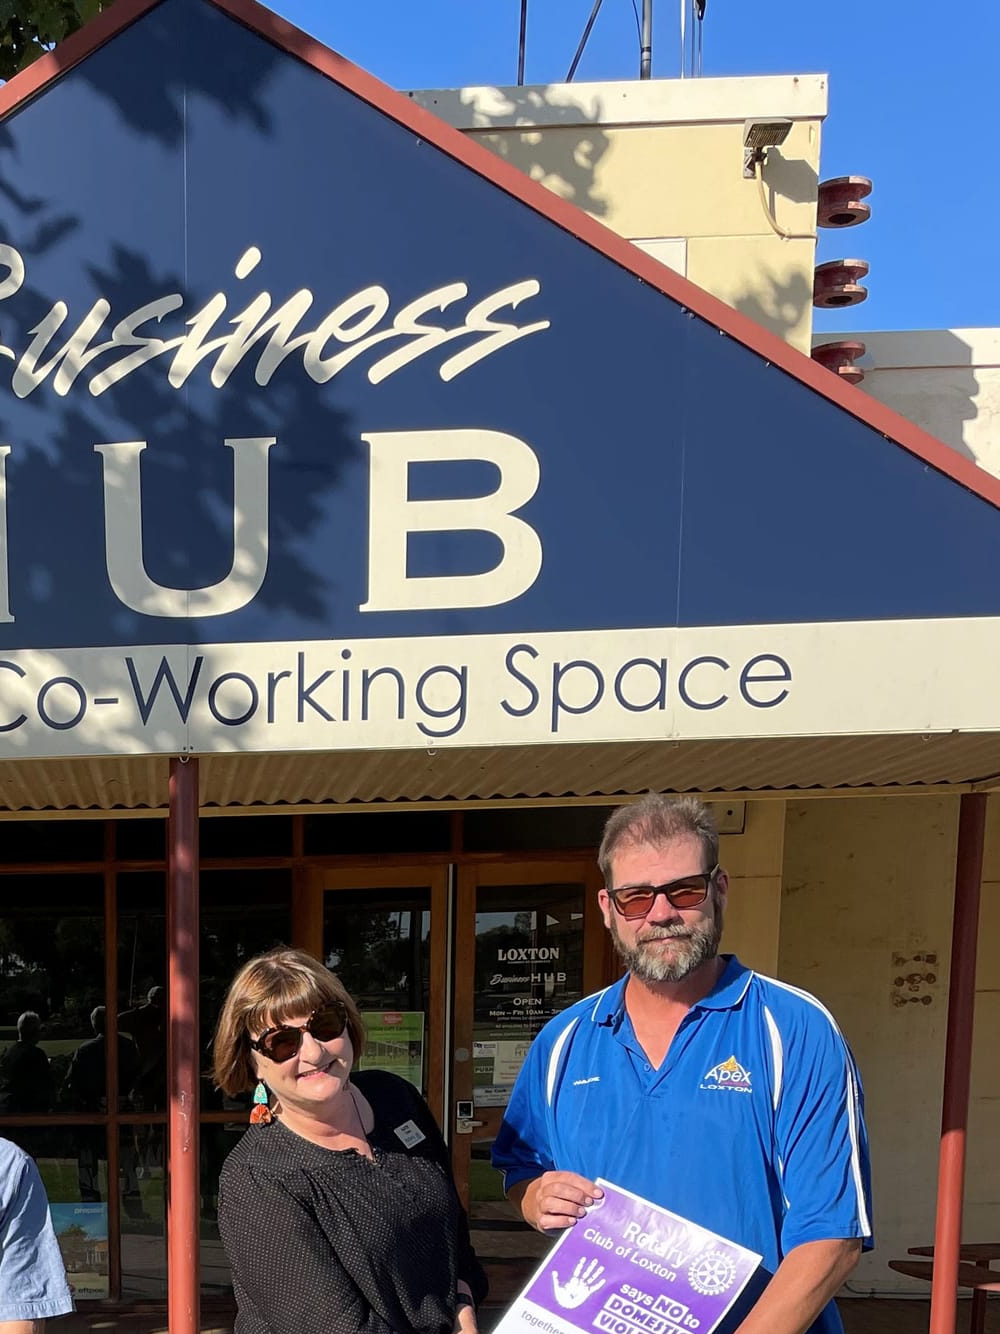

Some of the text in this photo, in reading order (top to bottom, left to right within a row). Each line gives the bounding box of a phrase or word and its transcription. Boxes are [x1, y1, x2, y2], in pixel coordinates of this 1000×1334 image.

[500, 642, 794, 733] Space
[497, 947, 560, 961] LOXTON
[490, 972, 567, 985] Business HUB
[700, 1083, 753, 1093] LOXTON
[704, 1066, 752, 1085] Apex
[583, 1228, 615, 1250] Club
[615, 1245, 633, 1258] of
[630, 1252, 678, 1283] Loxton
[622, 1221, 690, 1269] Rotary
[619, 1283, 702, 1330] says NO to
